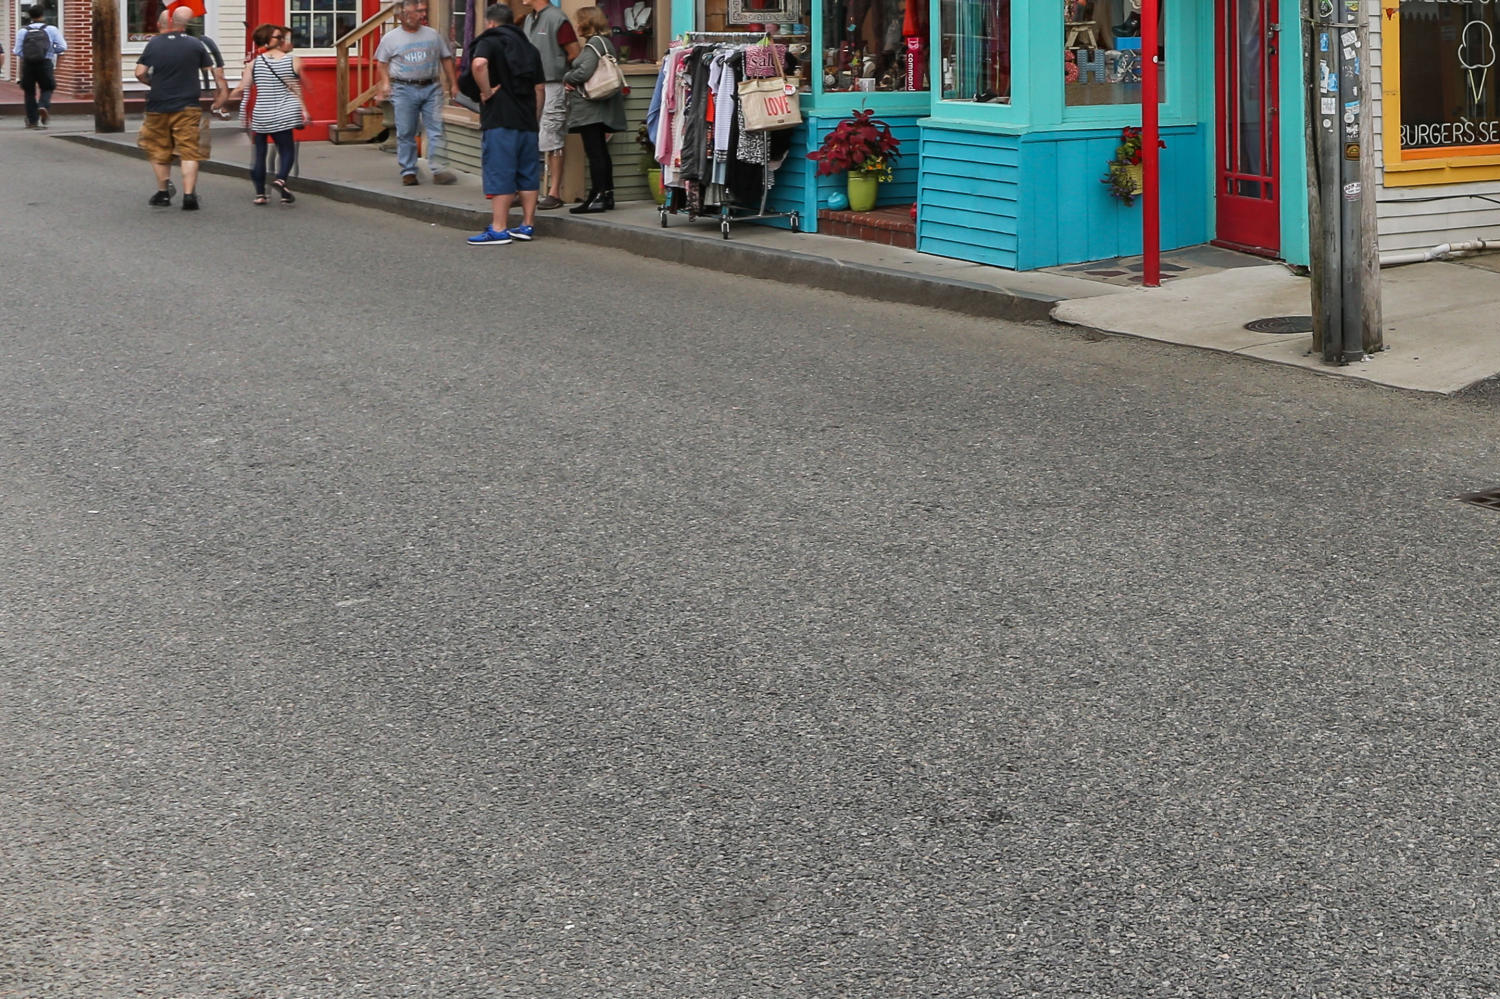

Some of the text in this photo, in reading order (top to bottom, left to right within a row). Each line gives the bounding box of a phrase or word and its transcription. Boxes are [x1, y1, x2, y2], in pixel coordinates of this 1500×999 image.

[751, 52, 776, 67] sal
[908, 52, 917, 92] command
[763, 95, 792, 117] LOVE
